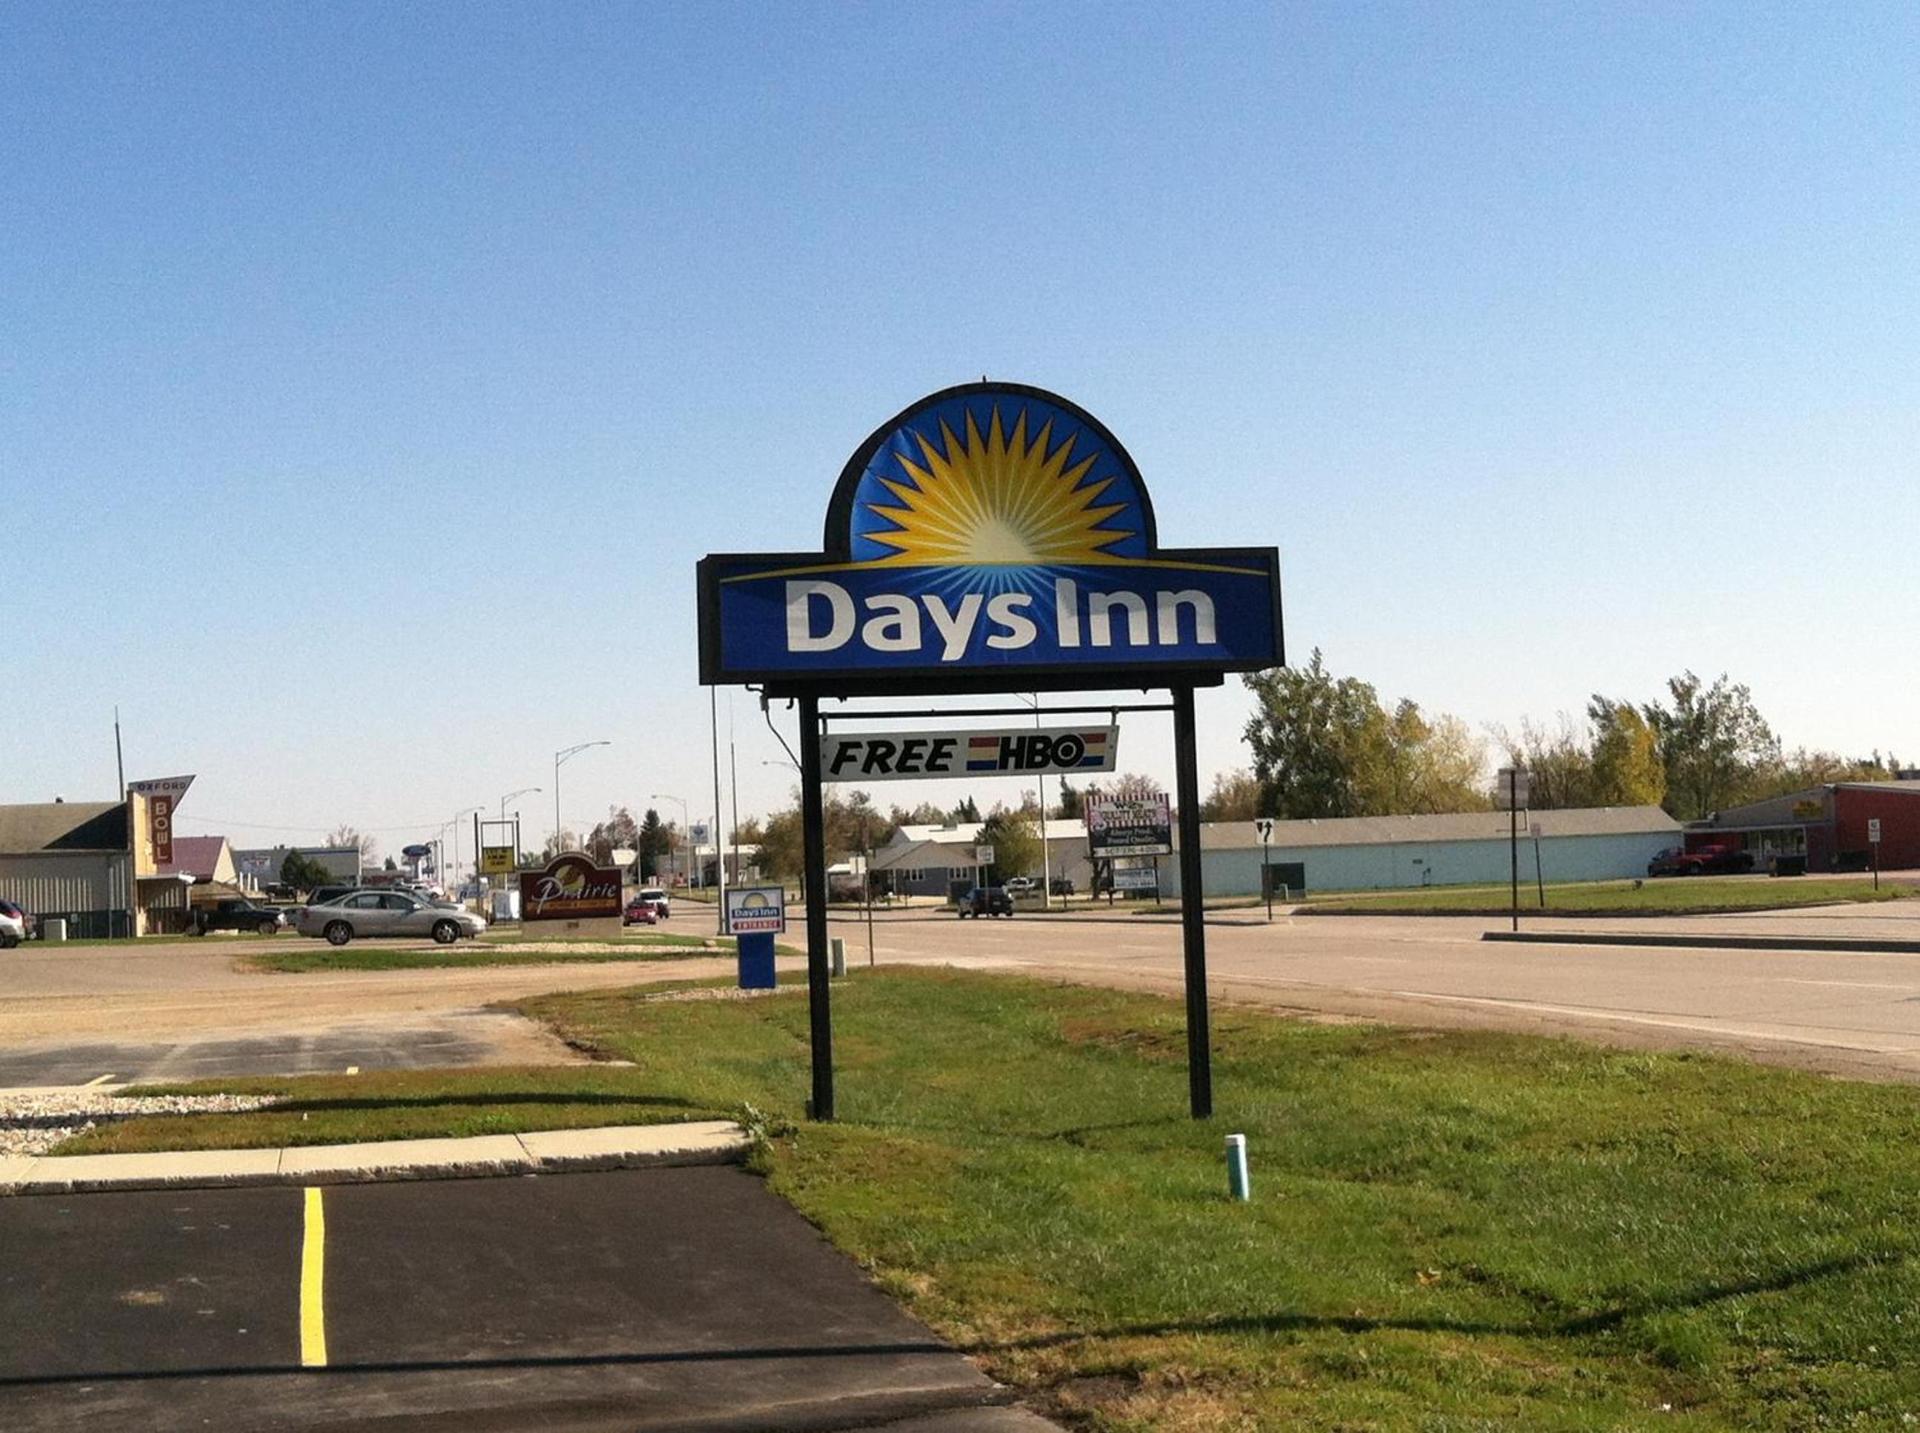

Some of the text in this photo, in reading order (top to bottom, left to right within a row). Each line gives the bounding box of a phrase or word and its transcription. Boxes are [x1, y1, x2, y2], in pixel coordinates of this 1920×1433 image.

[786, 578, 1217, 661] Days Inn
[829, 734, 1085, 775] FREE HBO
[137, 782, 186, 791] OXFORD
[155, 802, 168, 860] BOWL
[532, 877, 617, 915] Prairie
[735, 908, 777, 918] Days Inn
[737, 921, 778, 930] ENTRANCE
